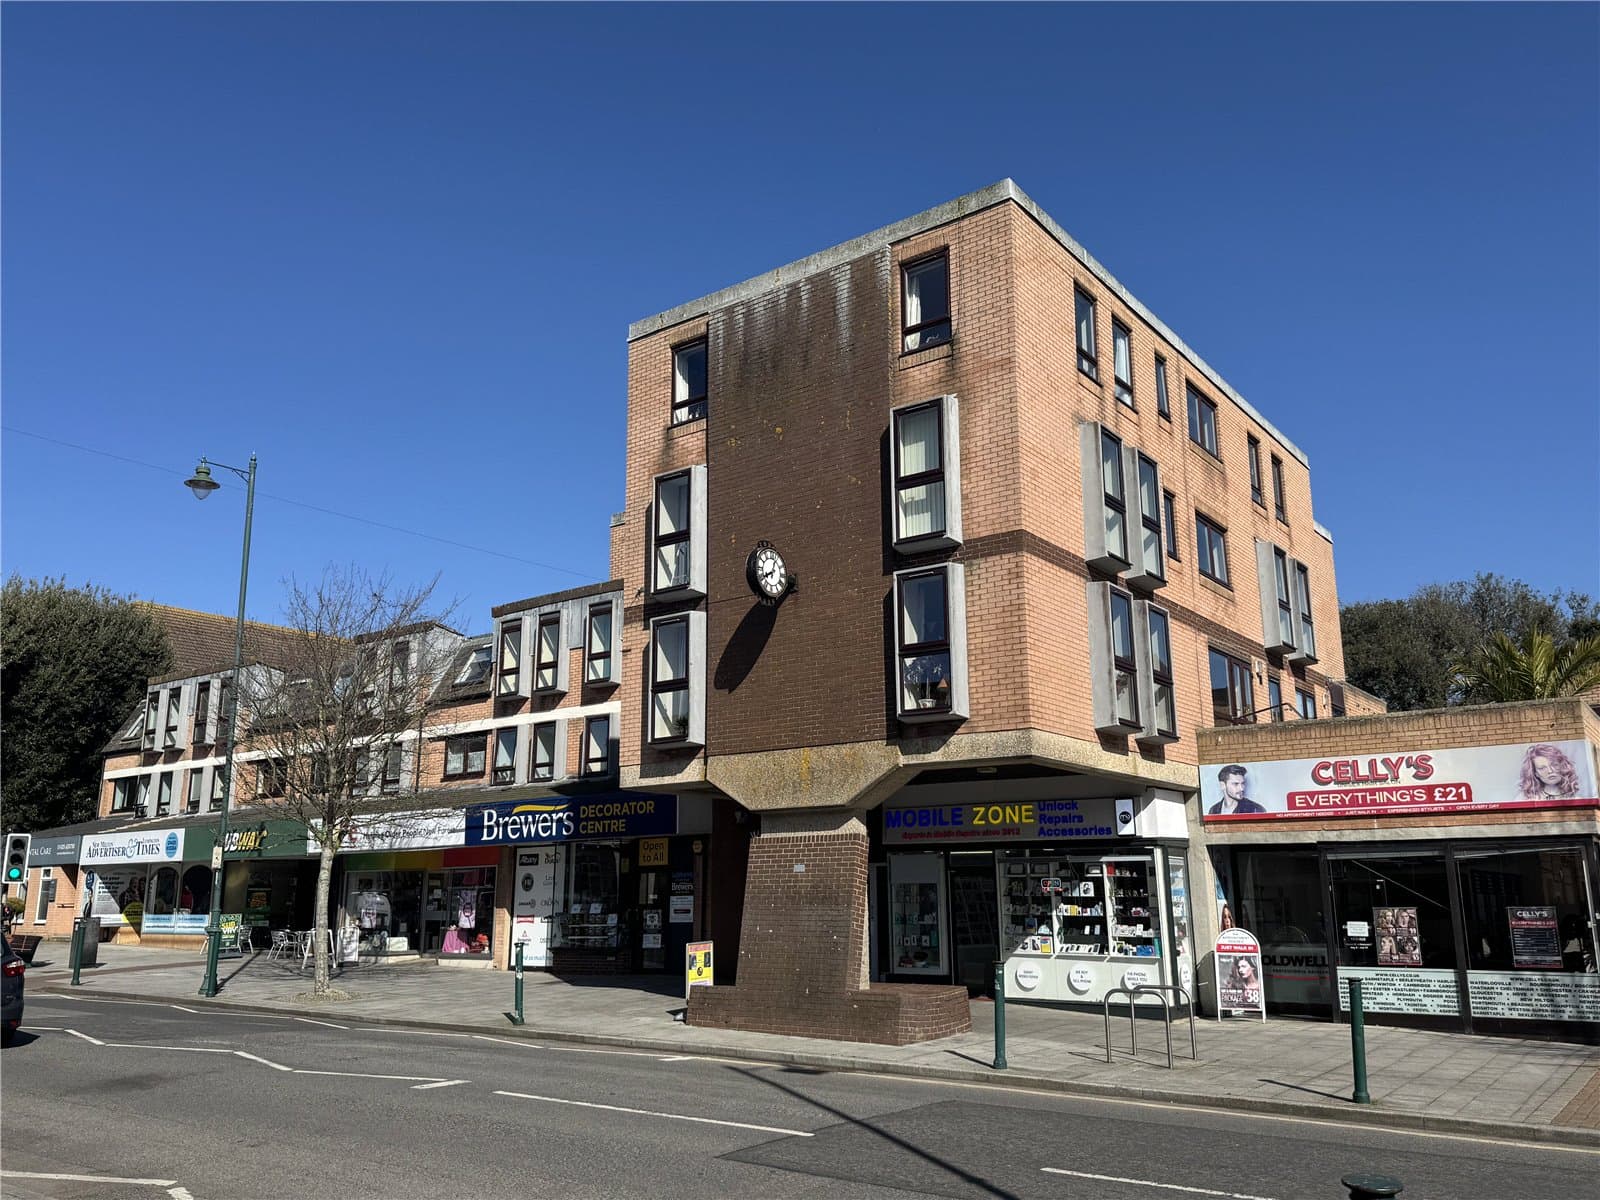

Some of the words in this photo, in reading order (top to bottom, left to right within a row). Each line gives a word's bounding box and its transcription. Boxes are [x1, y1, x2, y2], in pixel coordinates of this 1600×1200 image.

[1311, 755, 1434, 786] CELLY'S
[1295, 788, 1427, 807] EVERYTHING'S
[1433, 786, 1468, 801] £21
[579, 801, 655, 818] DECORATOR
[1038, 800, 1078, 811] Unlock
[886, 808, 963, 828] MOBILE
[972, 804, 1034, 825] ZONE
[1038, 813, 1084, 824] Repairs
[481, 807, 575, 841] Brewers
[579, 819, 626, 834] CENTRE
[1038, 826, 1113, 837] Accessories
[86, 845, 126, 858] ADVERTISER
[136, 842, 160, 855] TIMES
[643, 841, 664, 852] Open
[643, 854, 652, 862] to
[653, 852, 664, 862] All
[1262, 955, 1330, 967] OLDWELL
